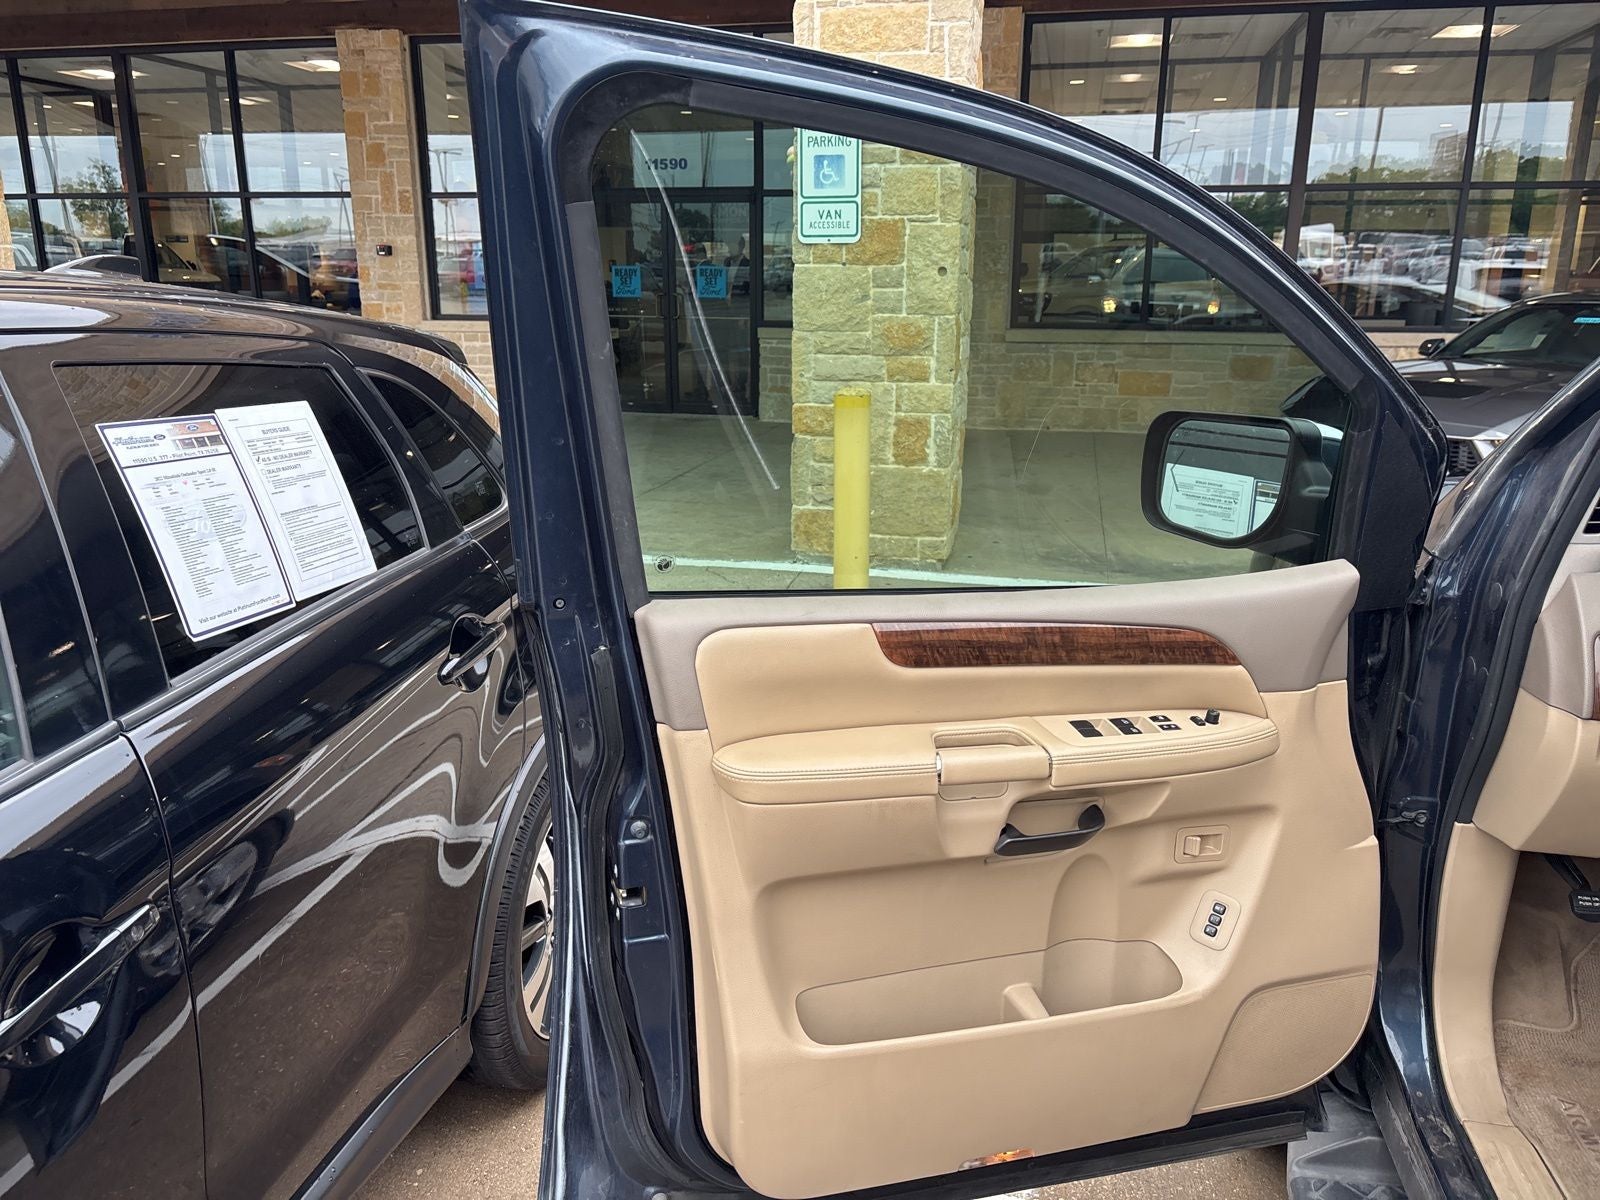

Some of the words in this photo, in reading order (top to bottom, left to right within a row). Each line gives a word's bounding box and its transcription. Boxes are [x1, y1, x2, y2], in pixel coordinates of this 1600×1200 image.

[807, 135, 852, 148] PARKING
[645, 157, 688, 170] 11590
[818, 209, 842, 220] VAN
[809, 220, 850, 230] ACCESSIBLE
[614, 268, 638, 278] READY
[700, 267, 723, 278] READY
[620, 277, 633, 286] SET
[704, 277, 718, 286] SET
